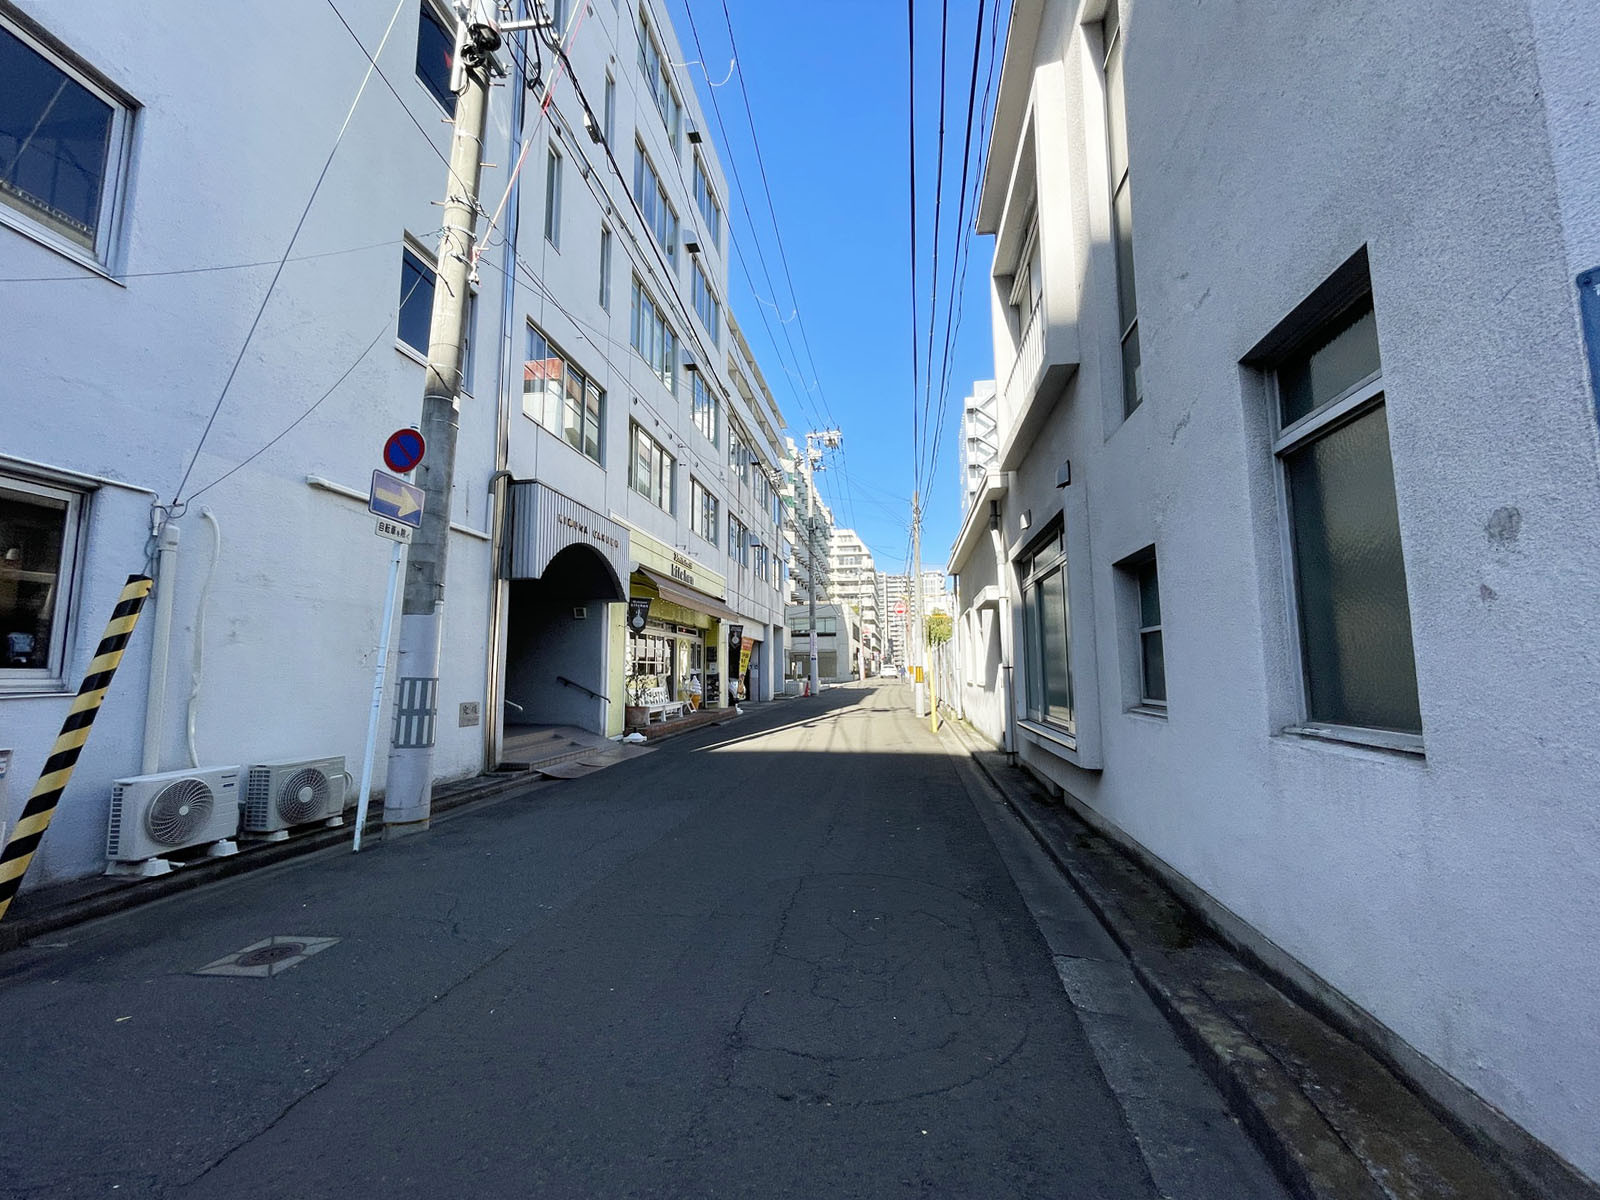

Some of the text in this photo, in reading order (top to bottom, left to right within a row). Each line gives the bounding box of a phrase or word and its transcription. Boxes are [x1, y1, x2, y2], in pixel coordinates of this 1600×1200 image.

[378, 521, 410, 539] 自転車を除く
